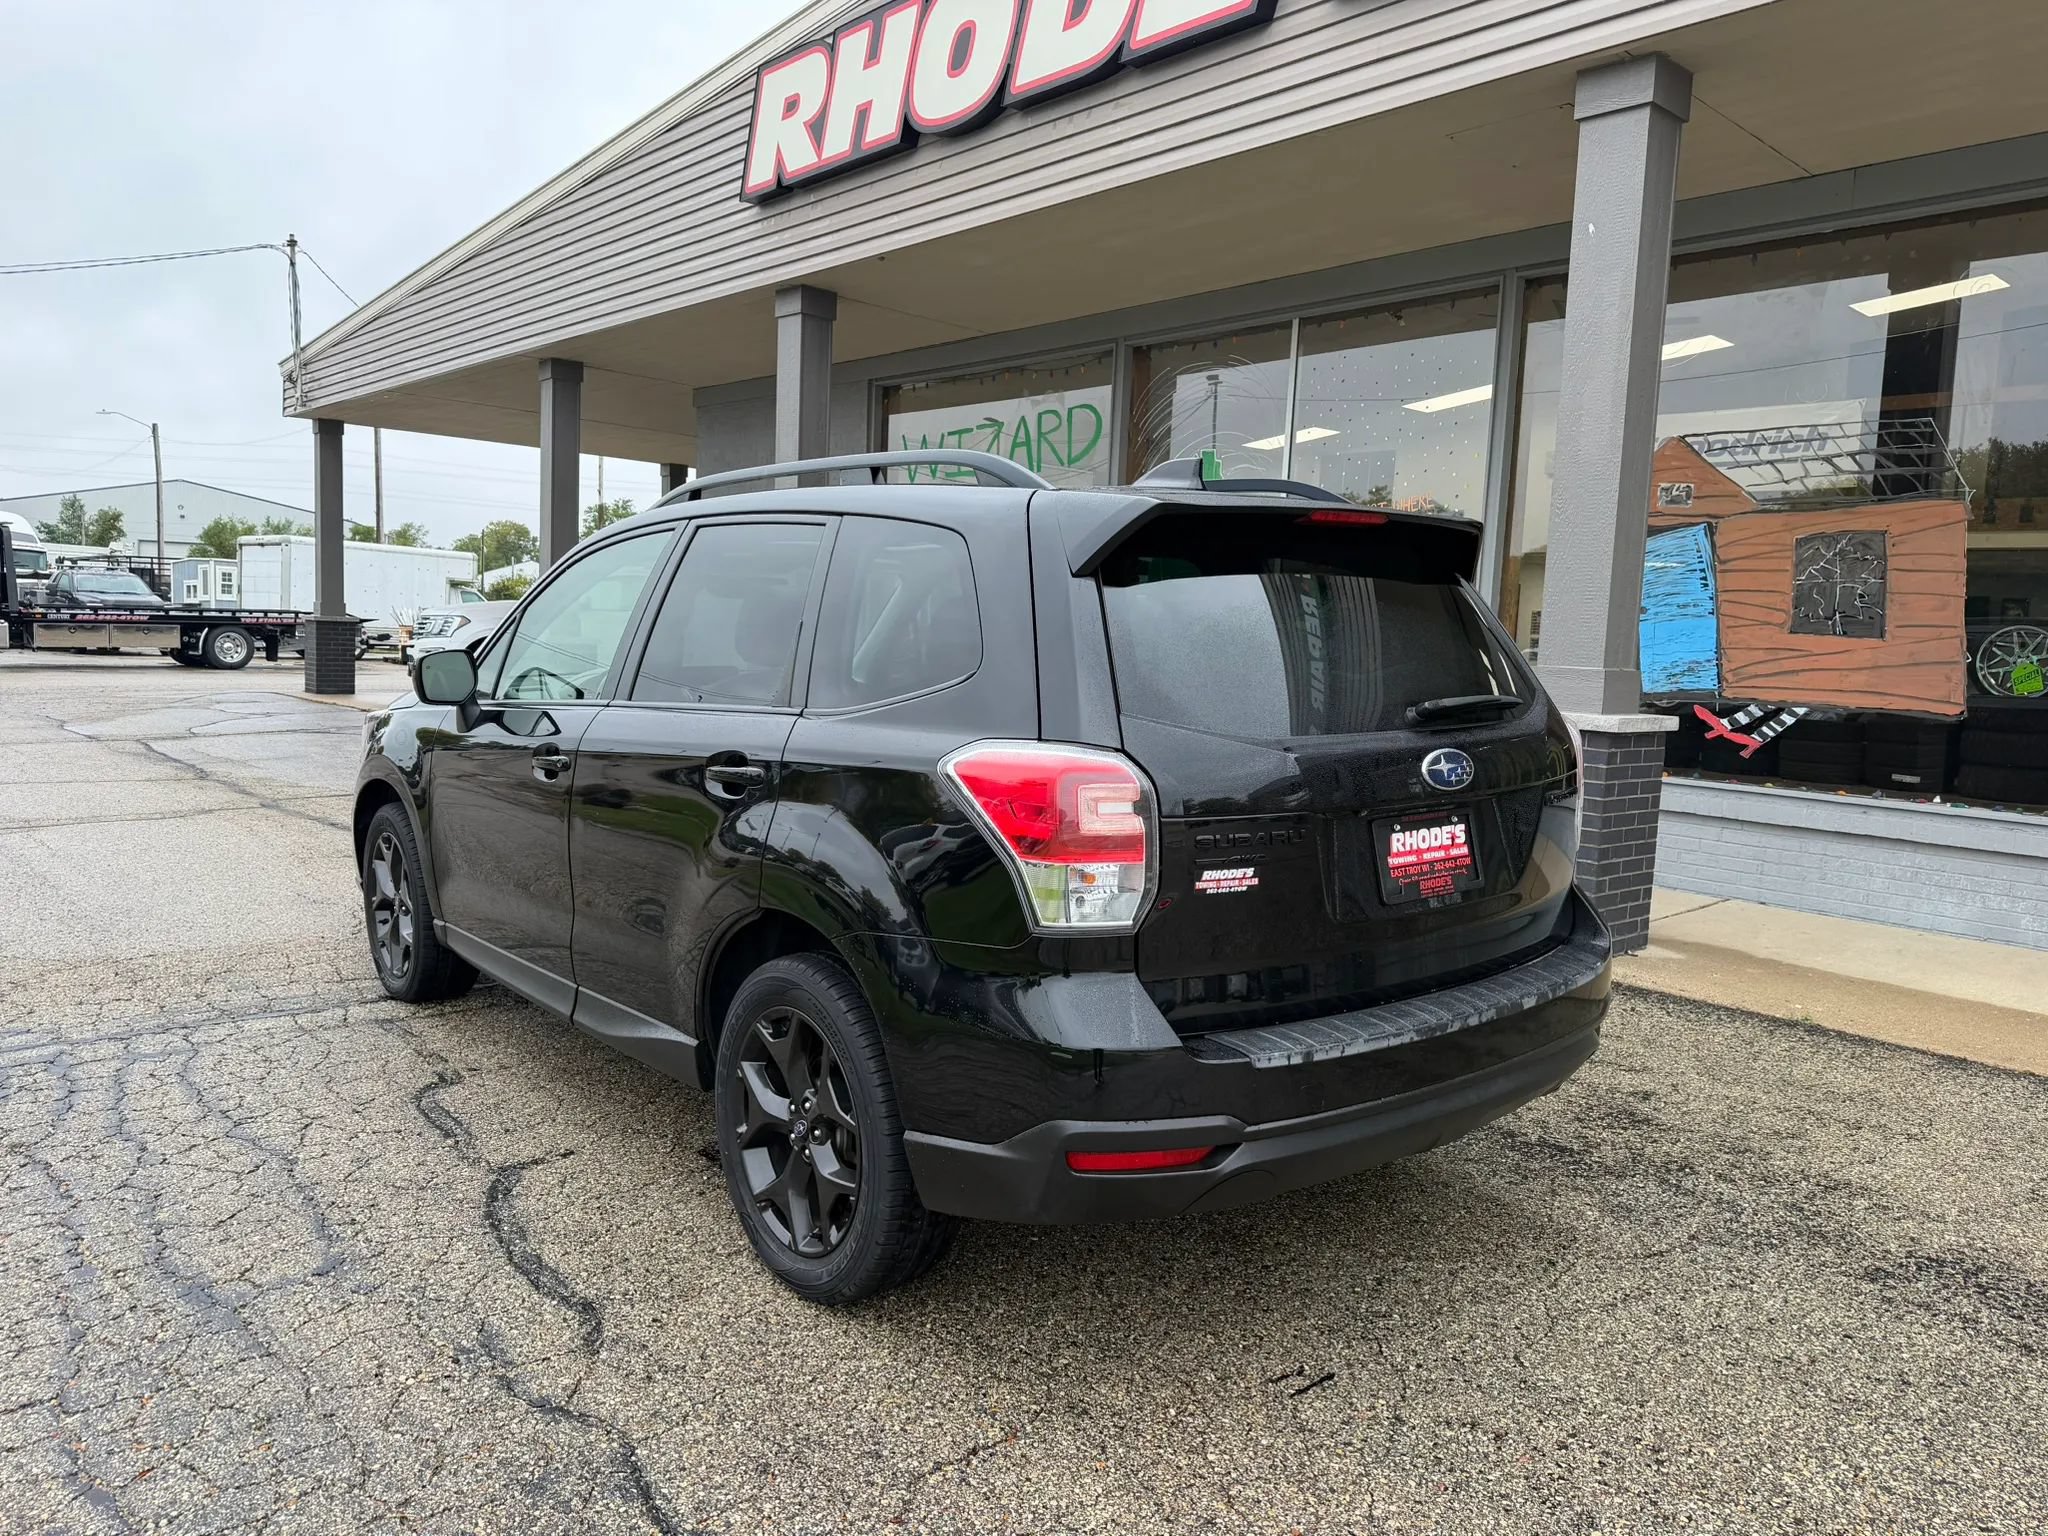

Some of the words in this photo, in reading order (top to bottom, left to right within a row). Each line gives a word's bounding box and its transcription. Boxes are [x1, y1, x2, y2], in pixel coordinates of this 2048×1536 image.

[2013, 668, 2041, 686] SPECIAL
[1195, 829, 1306, 849] SUBARU
[1391, 824, 1466, 853] RHODE'S
[1388, 855, 1417, 865] TOWING
[1423, 852, 1445, 860] REPAIR
[1450, 846, 1469, 856] SALES
[1201, 867, 1255, 880] RHODE'S
[1391, 869, 1406, 877] EAST
[1407, 866, 1421, 875] TROY
[1421, 865, 1430, 873] WI
[1196, 881, 1217, 890] TOWING
[1220, 879, 1240, 888] REPAIR
[1242, 878, 1259, 886] SALES
[1420, 876, 1452, 890] RHODE'S
